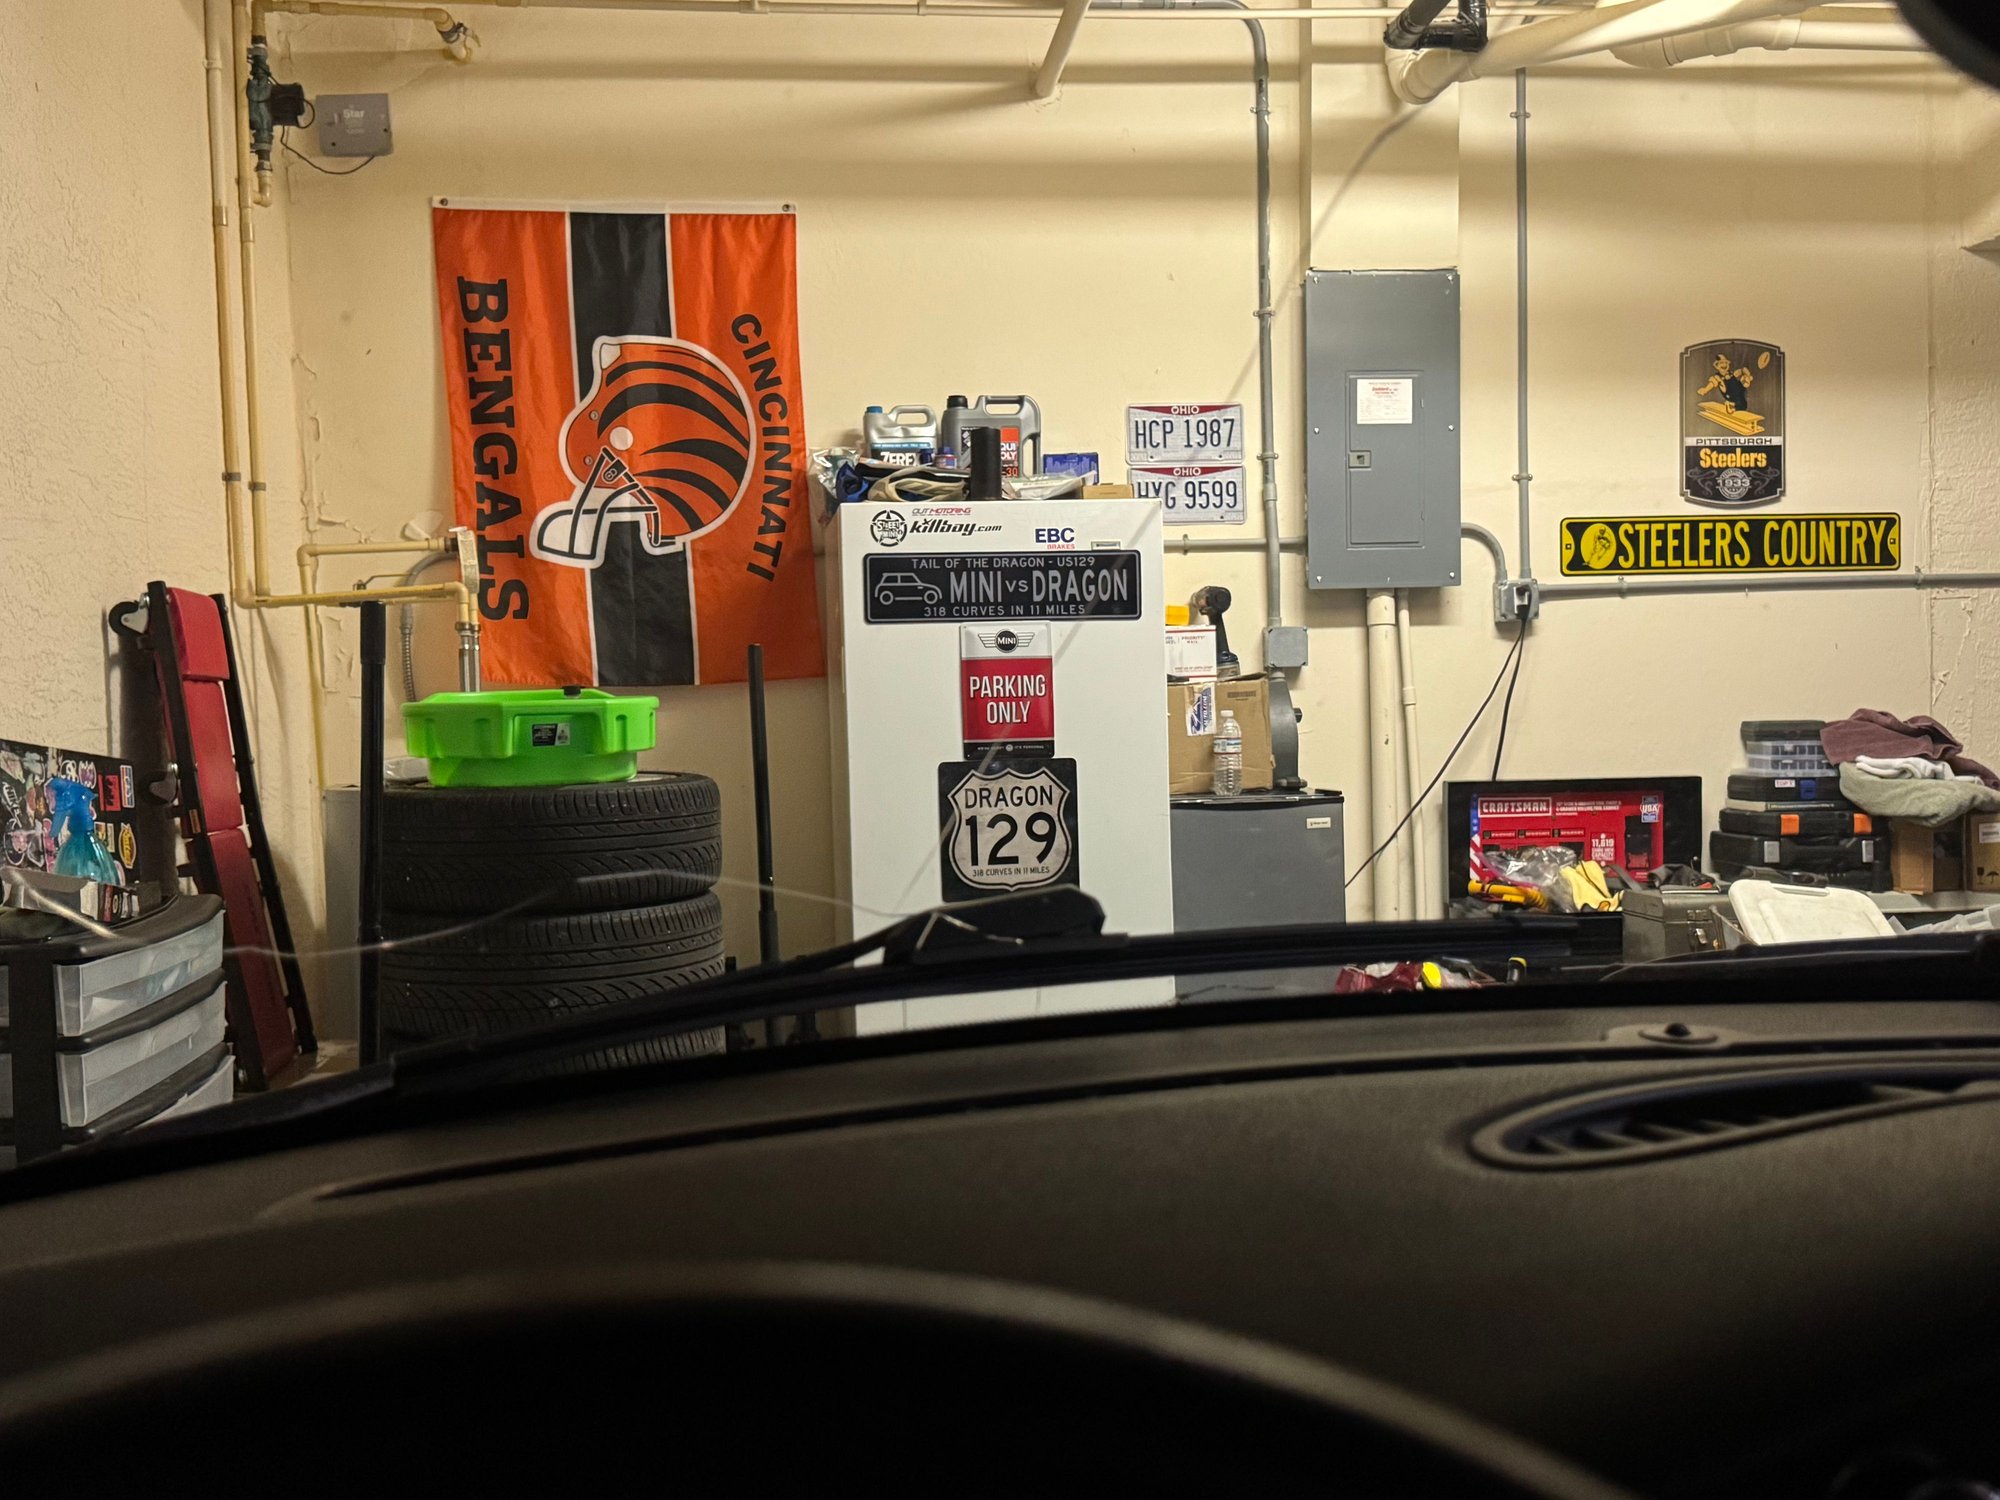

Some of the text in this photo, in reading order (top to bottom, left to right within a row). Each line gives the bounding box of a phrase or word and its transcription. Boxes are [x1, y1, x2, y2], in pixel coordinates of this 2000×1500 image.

[1170, 405, 1200, 415] OHIO
[1134, 418, 1235, 449] HCP 1987
[1695, 437, 1773, 445] PITTSBURGH
[456, 275, 530, 621] BENGALS
[731, 313, 791, 582] CINCINNATI
[1000, 451, 1016, 460] OLY
[1699, 447, 1767, 468] Steelers
[1172, 467, 1202, 476] OHIO
[1716, 479, 1751, 487] 1933
[1184, 480, 1237, 509] 9599
[911, 507, 929, 515] OUT
[1034, 527, 1075, 543] EBC
[1618, 520, 1887, 568] STEELERS COUNTRY
[911, 559, 941, 569] TAIL
[944, 558, 961, 569] OF
[966, 558, 989, 568] THE
[993, 557, 1045, 568] DRAGON
[1056, 556, 1096, 567] US129
[950, 570, 1002, 604] MINI
[1032, 568, 1128, 602] DRAGON
[923, 604, 1086, 617] 318 CURVES IN 11 MILES
[997, 636, 1017, 645] MINI
[969, 674, 1046, 698] PARKING
[986, 701, 1031, 724] ONLY
[964, 785, 1053, 809] DRAGON
[1482, 800, 1549, 814] CRAFTSMAN
[1642, 803, 1657, 814] USA
[965, 811, 1057, 866] 129
[972, 869, 984, 877] 318
[985, 867, 1013, 877] CURVES
[1029, 866, 1050, 874] MILES
